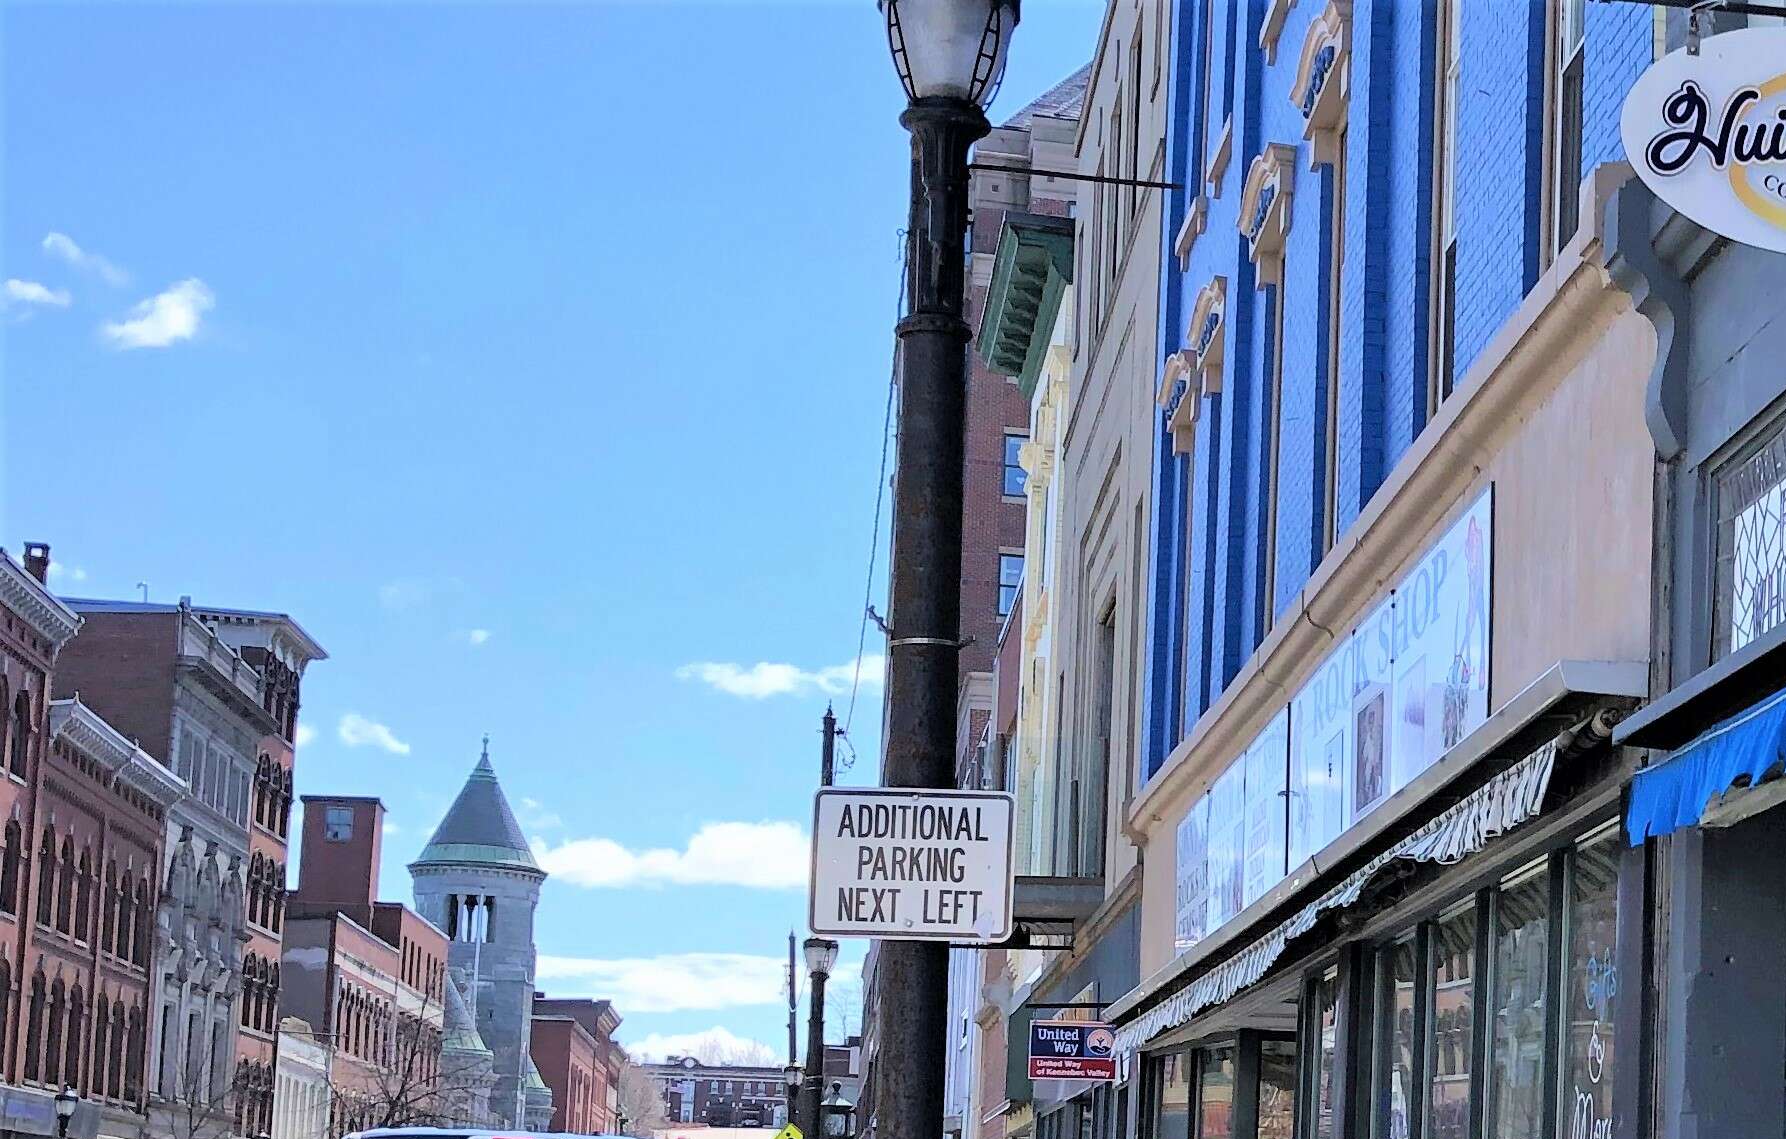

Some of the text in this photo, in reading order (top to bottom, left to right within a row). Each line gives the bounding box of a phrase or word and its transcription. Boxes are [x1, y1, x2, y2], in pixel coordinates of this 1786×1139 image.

[1313, 549, 1448, 738] ROCK SHOP
[837, 804, 988, 841] ADDITIONAL
[857, 846, 966, 883] PARKING
[837, 887, 983, 928] NEXT LEFT
[1037, 1028, 1079, 1040] United
[1053, 1041, 1079, 1056] Way
[1036, 1060, 1081, 1069] United Way
